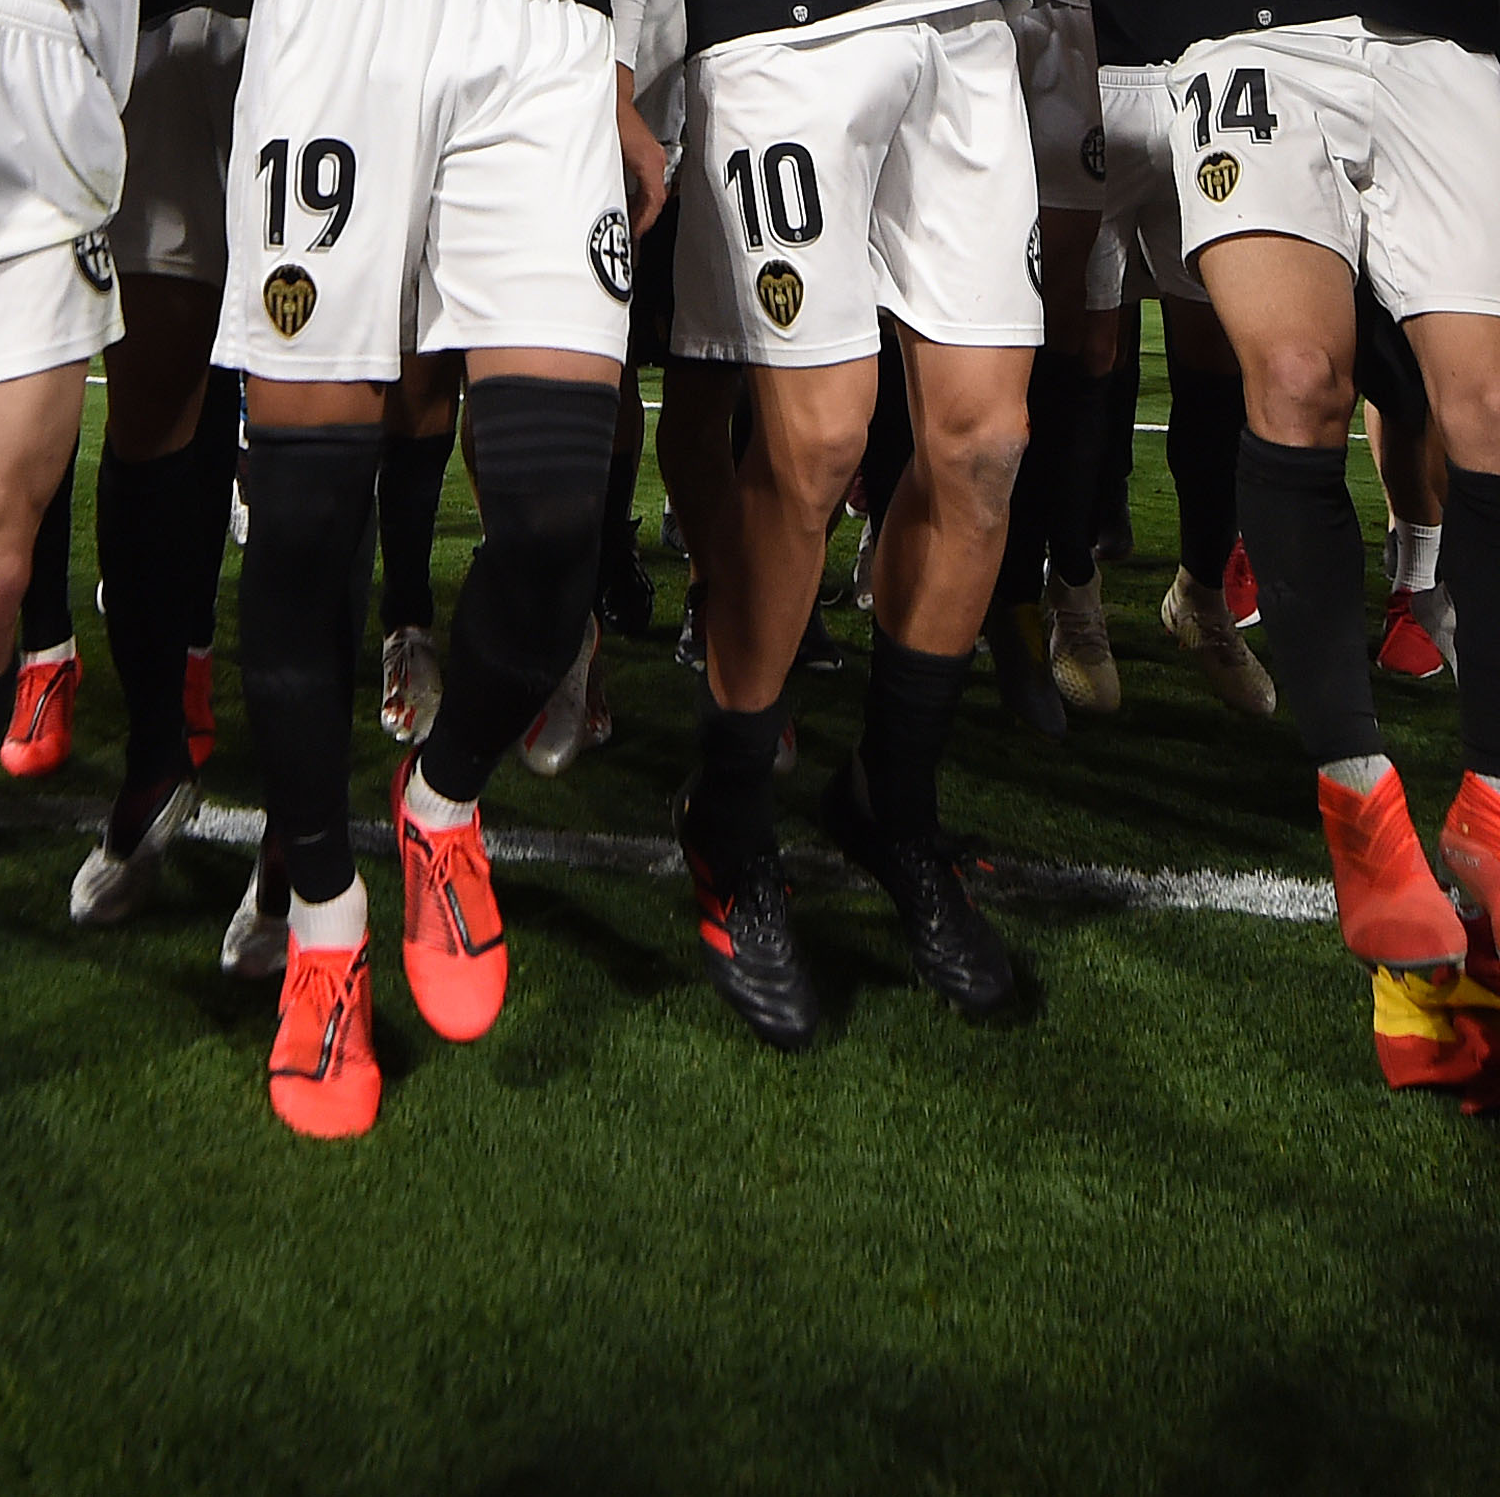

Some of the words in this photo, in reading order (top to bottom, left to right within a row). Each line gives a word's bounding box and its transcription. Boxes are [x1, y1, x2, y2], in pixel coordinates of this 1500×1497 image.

[1182, 67, 1278, 152] 14
[255, 137, 357, 252] 19
[724, 142, 824, 253] 10
